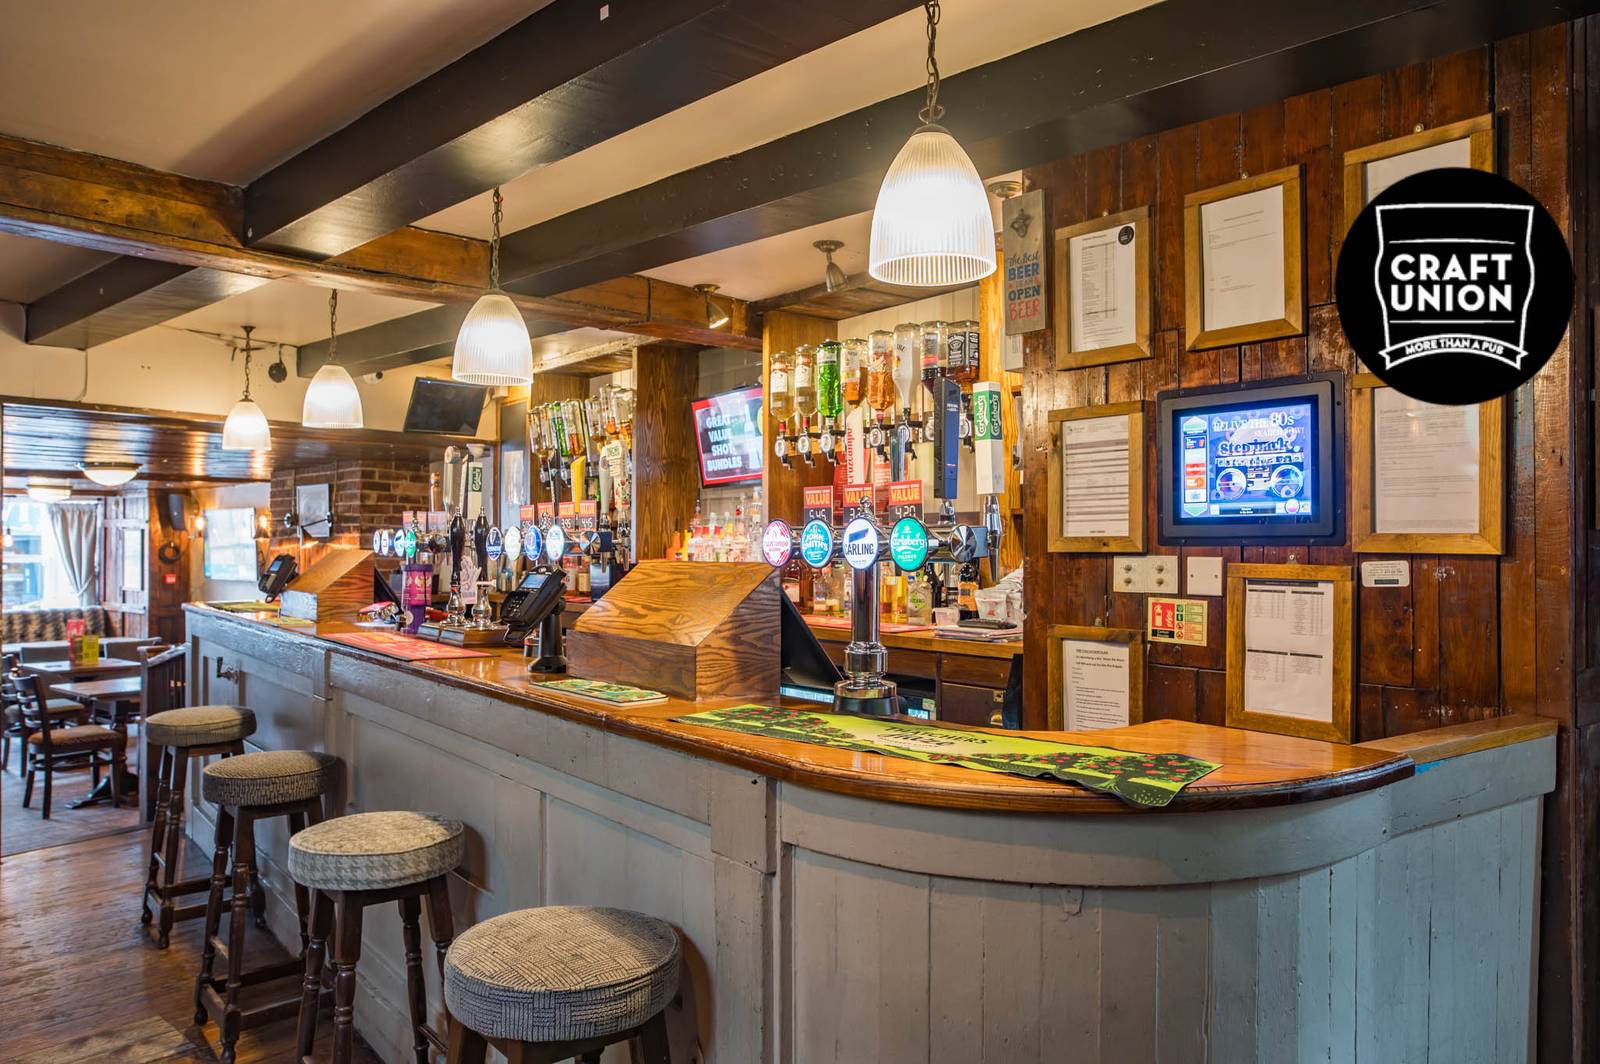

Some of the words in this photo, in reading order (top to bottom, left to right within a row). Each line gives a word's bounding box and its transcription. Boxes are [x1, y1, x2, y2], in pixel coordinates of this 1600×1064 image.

[1008, 262, 1040, 281] BEER
[1008, 285, 1041, 301] OPEN
[1009, 298, 1041, 321] BEER
[706, 415, 731, 429] GREAT
[975, 395, 986, 437] Carlsberg
[991, 394, 1001, 436] Carlsberg
[1270, 411, 1295, 427] 80s
[708, 429, 732, 443] VALUE
[706, 456, 742, 472] BUNDLES
[805, 493, 831, 506] VALUE
[890, 488, 920, 502] VALUE
[806, 533, 825, 542] JOHN
[891, 532, 926, 549] Carlsberg
[844, 543, 875, 556] CARLING
